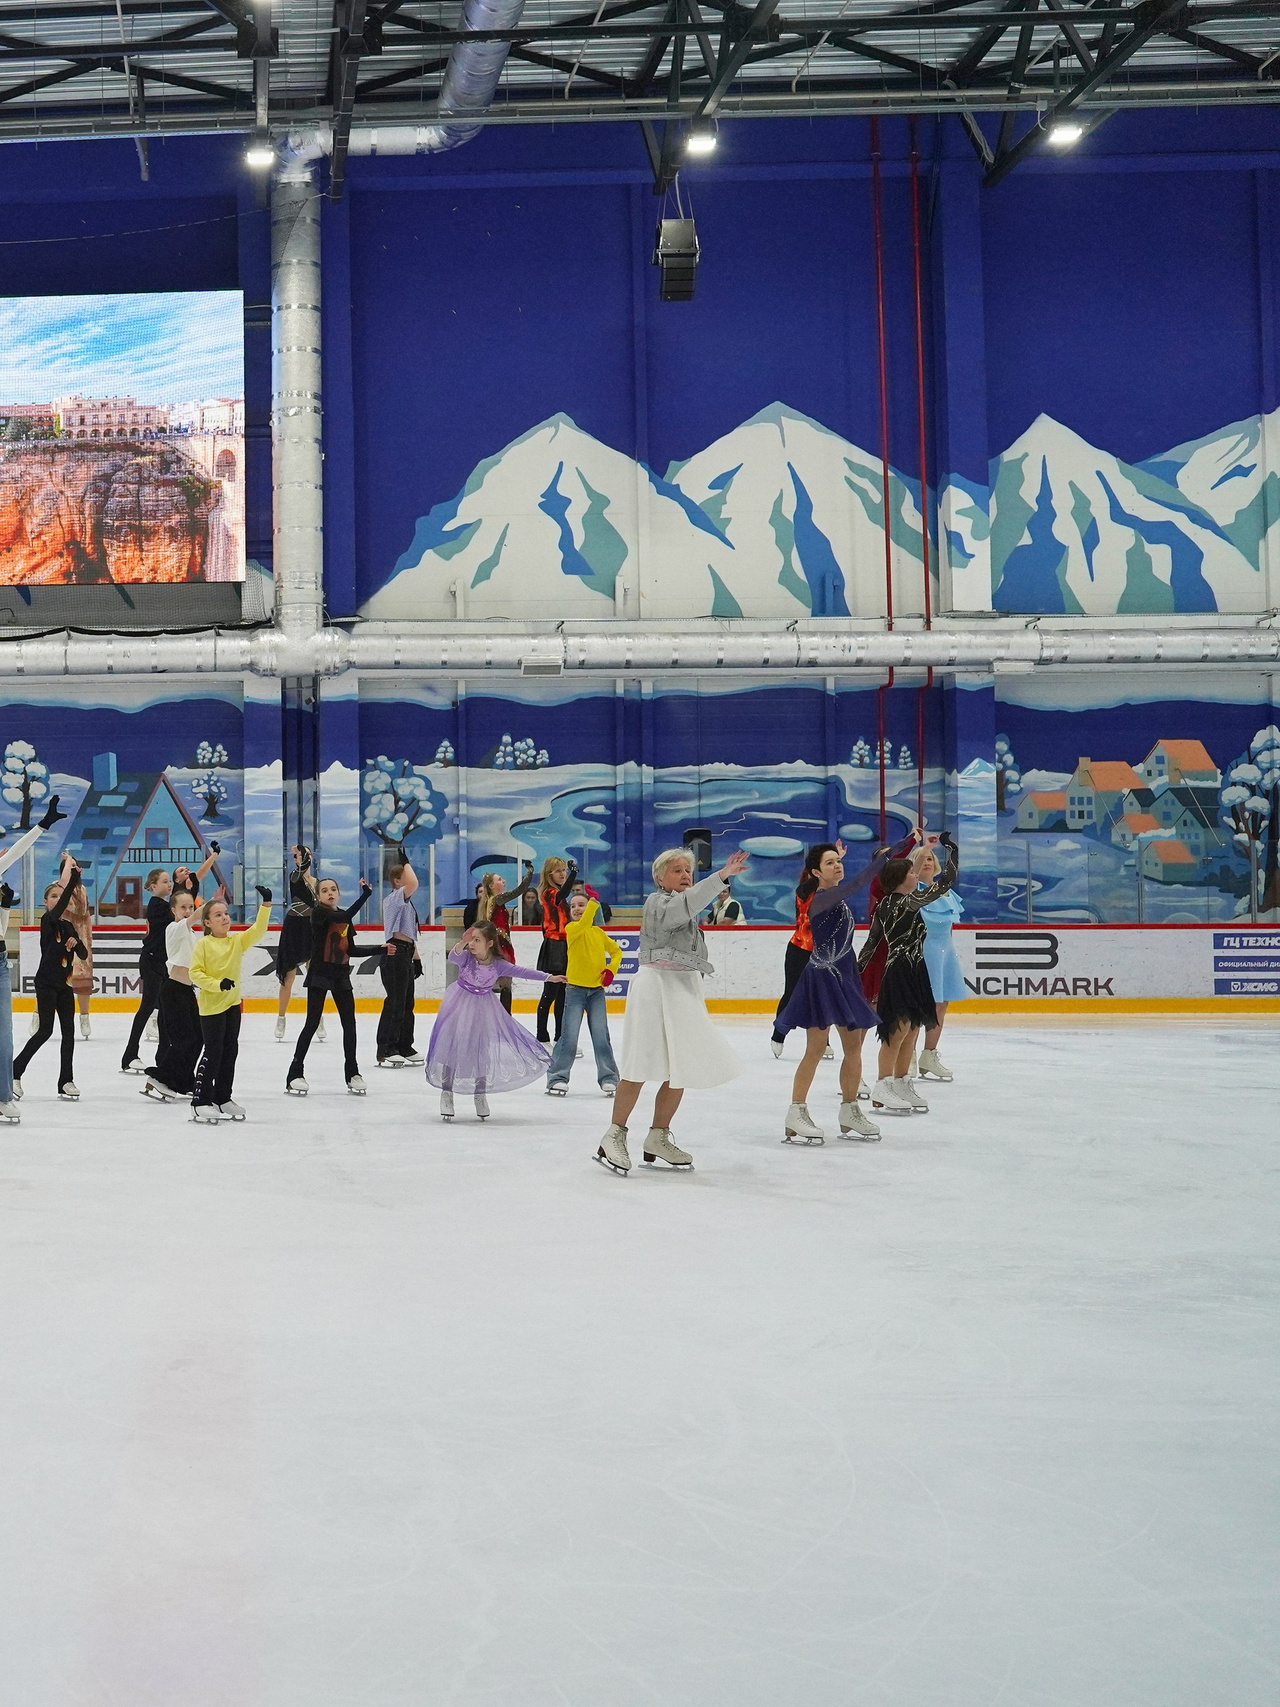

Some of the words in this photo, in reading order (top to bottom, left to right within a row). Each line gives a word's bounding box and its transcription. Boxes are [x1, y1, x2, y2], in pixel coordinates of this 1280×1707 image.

[1223, 937, 1240, 948] ГЦ
[1218, 960, 1269, 968] ОФИЦИАЛЬНЫЙ
[964, 977, 1115, 996] NCHMARK
